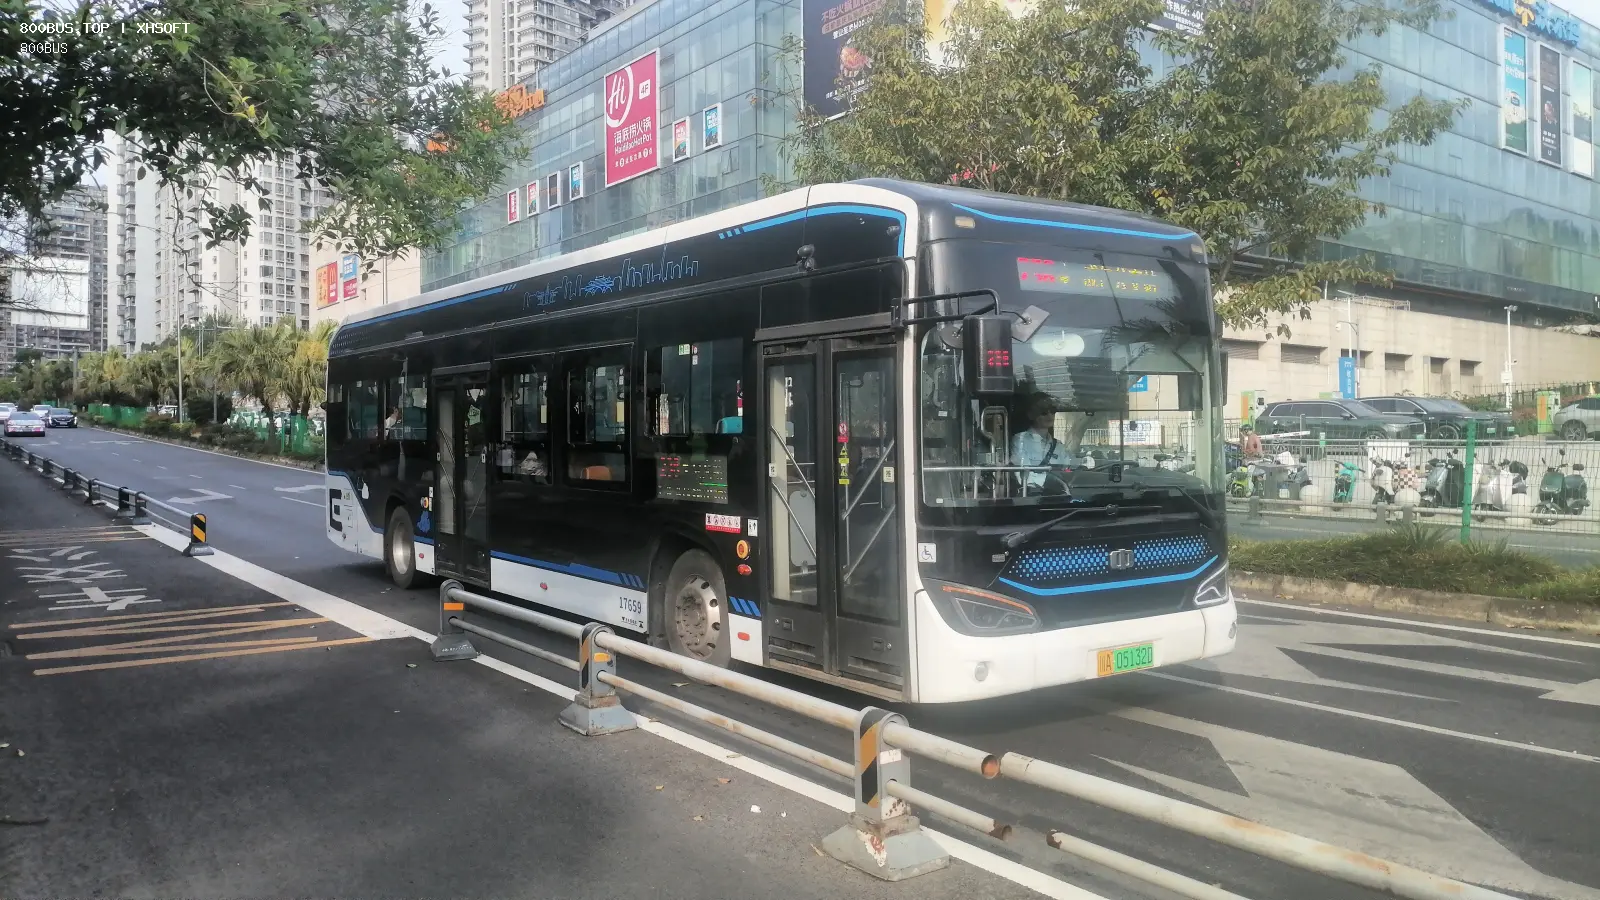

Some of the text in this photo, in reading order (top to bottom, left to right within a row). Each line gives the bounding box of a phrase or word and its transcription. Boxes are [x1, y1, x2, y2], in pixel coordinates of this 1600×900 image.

[607, 74, 627, 115] Hi
[640, 83, 649, 95] 4F
[613, 116, 652, 146] 海底捞火锅
[619, 596, 642, 614] 17659
[1099, 653, 1112, 673] 川A
